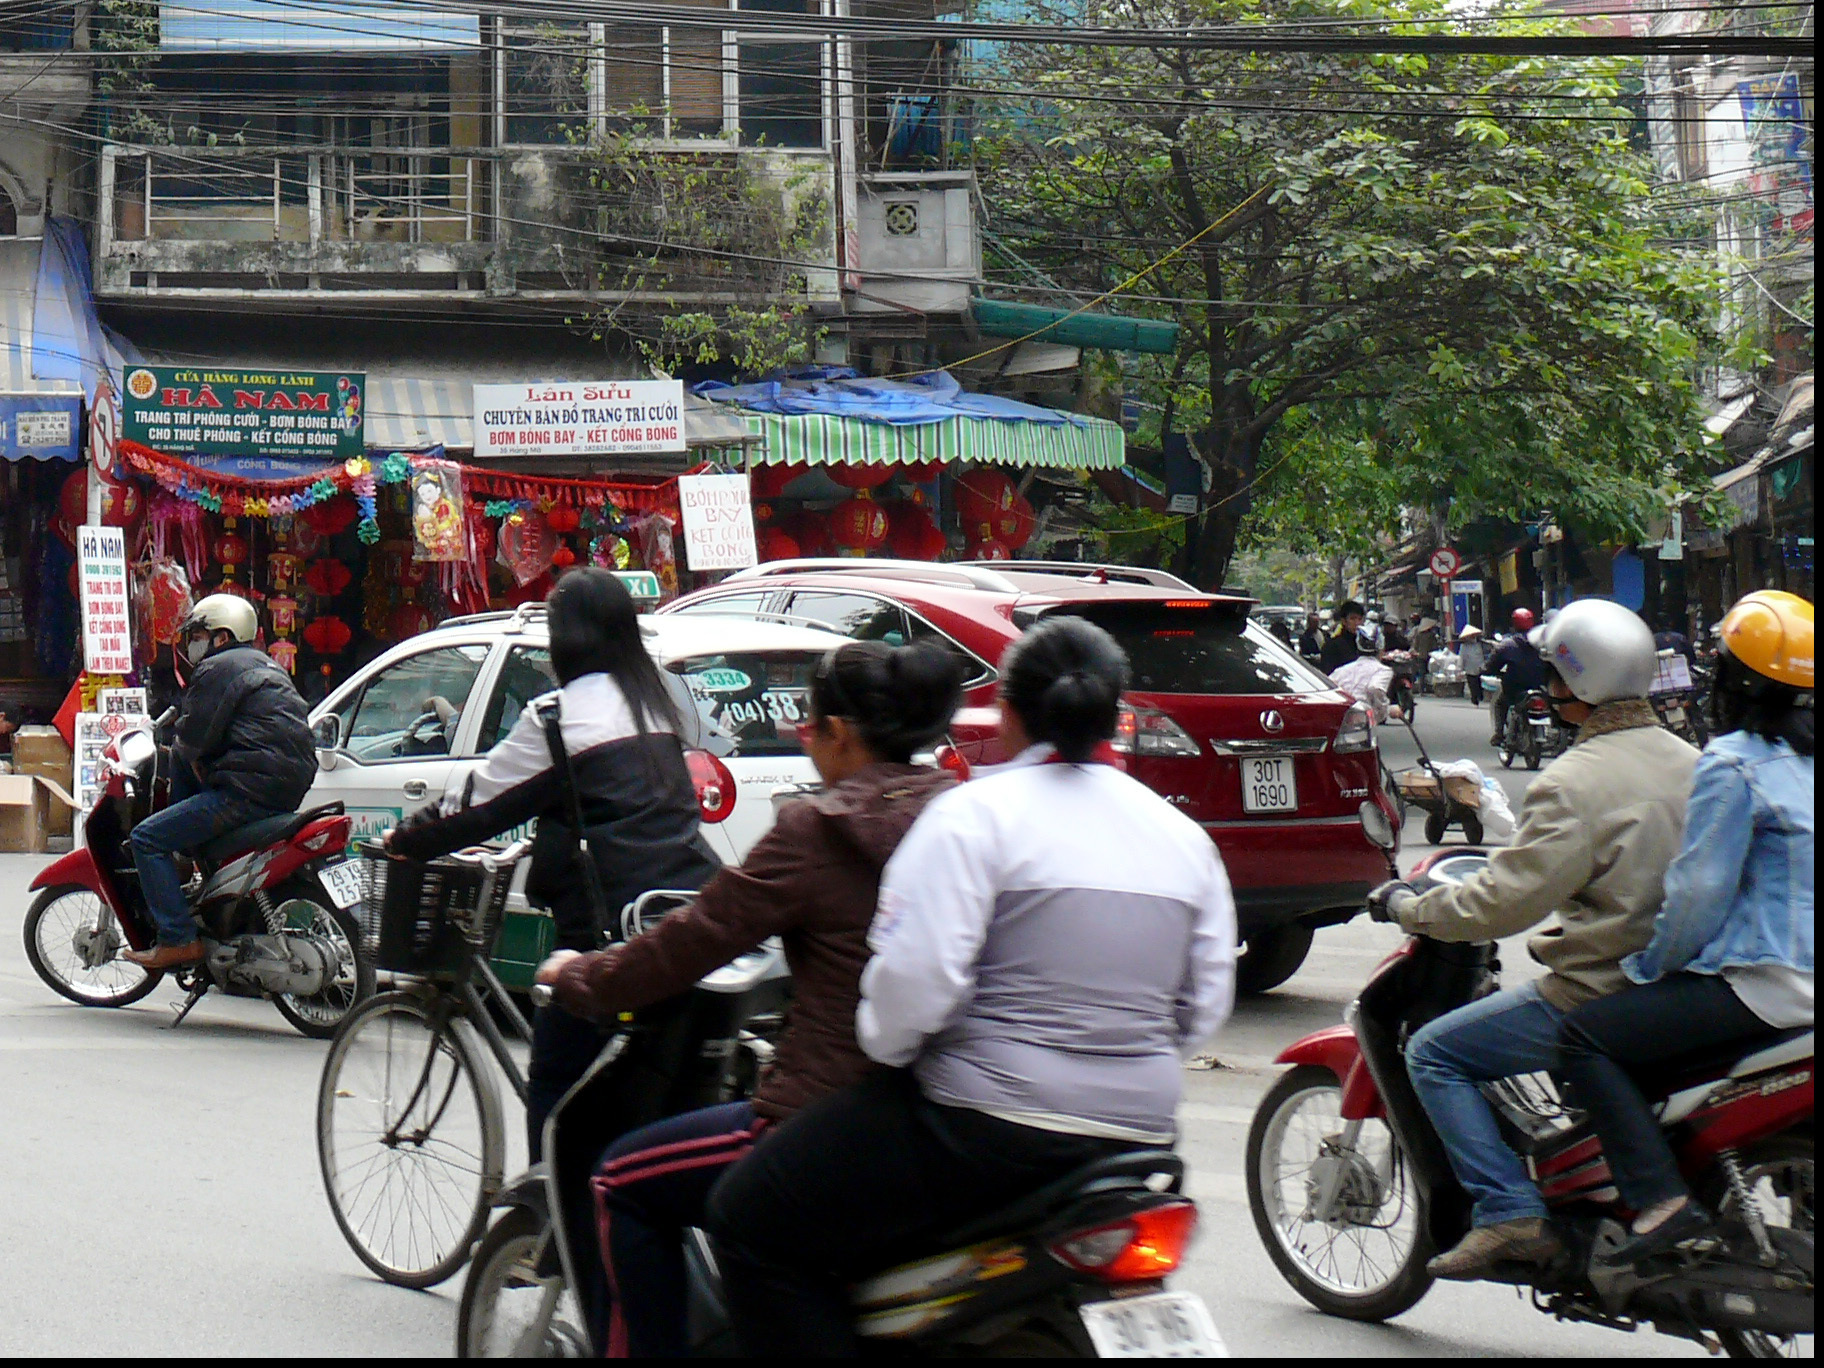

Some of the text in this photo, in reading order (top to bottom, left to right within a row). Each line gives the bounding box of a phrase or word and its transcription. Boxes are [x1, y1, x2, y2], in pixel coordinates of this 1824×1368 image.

[242, 376, 277, 385] LONG
[233, 389, 330, 412] NAM
[525, 387, 574, 402] Lân
[134, 410, 171, 424] TRANG
[330, 416, 353, 430] BAY
[483, 405, 533, 425] CHUYÊN
[581, 407, 623, 423] TRANG
[148, 427, 171, 440] CHO
[489, 430, 516, 445] BƠM
[554, 430, 576, 444] BAY
[587, 424, 608, 443] KẾT
[83, 529, 122, 559] HÀ NAM
[627, 576, 649, 595] Xi
[702, 671, 747, 686] 3334
[1253, 761, 1282, 783] 30T
[1252, 784, 1288, 809] 1690
